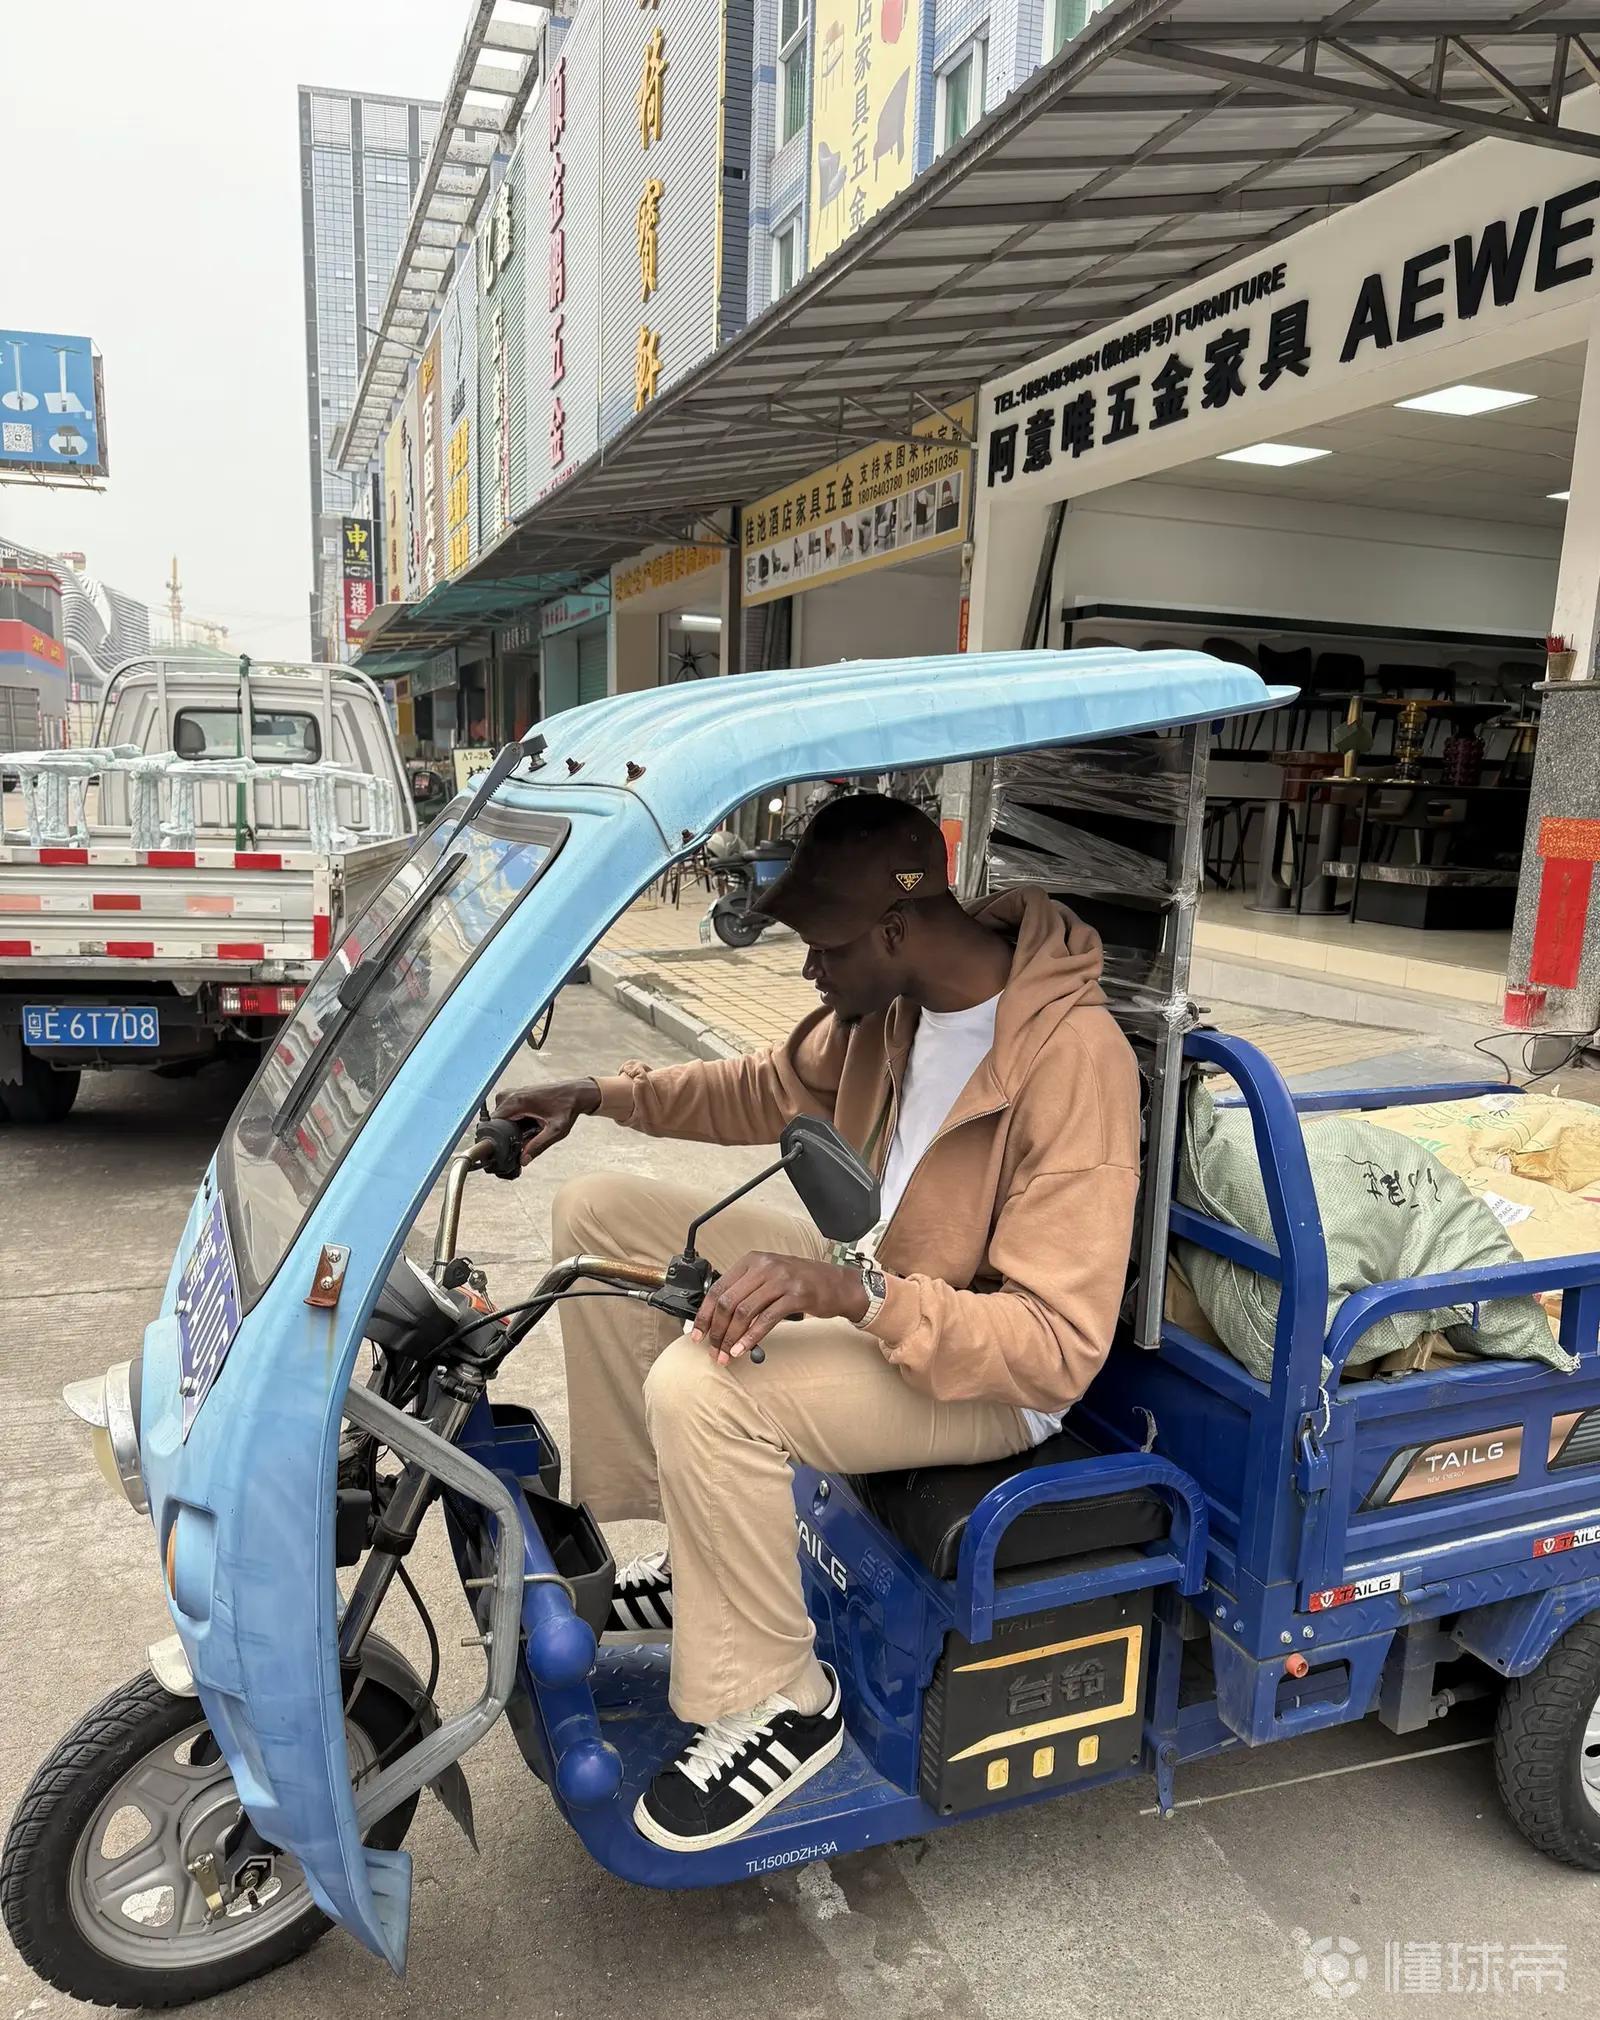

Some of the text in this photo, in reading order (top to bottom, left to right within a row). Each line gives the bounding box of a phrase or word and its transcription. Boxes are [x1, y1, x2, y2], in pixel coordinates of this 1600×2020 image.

[848, 0, 873, 232] 店家具五金
[1174, 262, 1288, 337] FURNITURE
[987, 179, 1600, 489] 阿意唯五金家具 AEWE
[745, 472, 854, 547] 佳池酒店家具五金
[857, 452, 960, 506] 18076403780 19015610356
[1425, 1441, 1504, 1473] TAILG
[796, 1514, 848, 1591] AILG
[1341, 1578, 1391, 1602] TAILG
[1006, 1658, 1106, 1717] 台铃
[745, 1840, 838, 1874] TL1500DZH-3A
